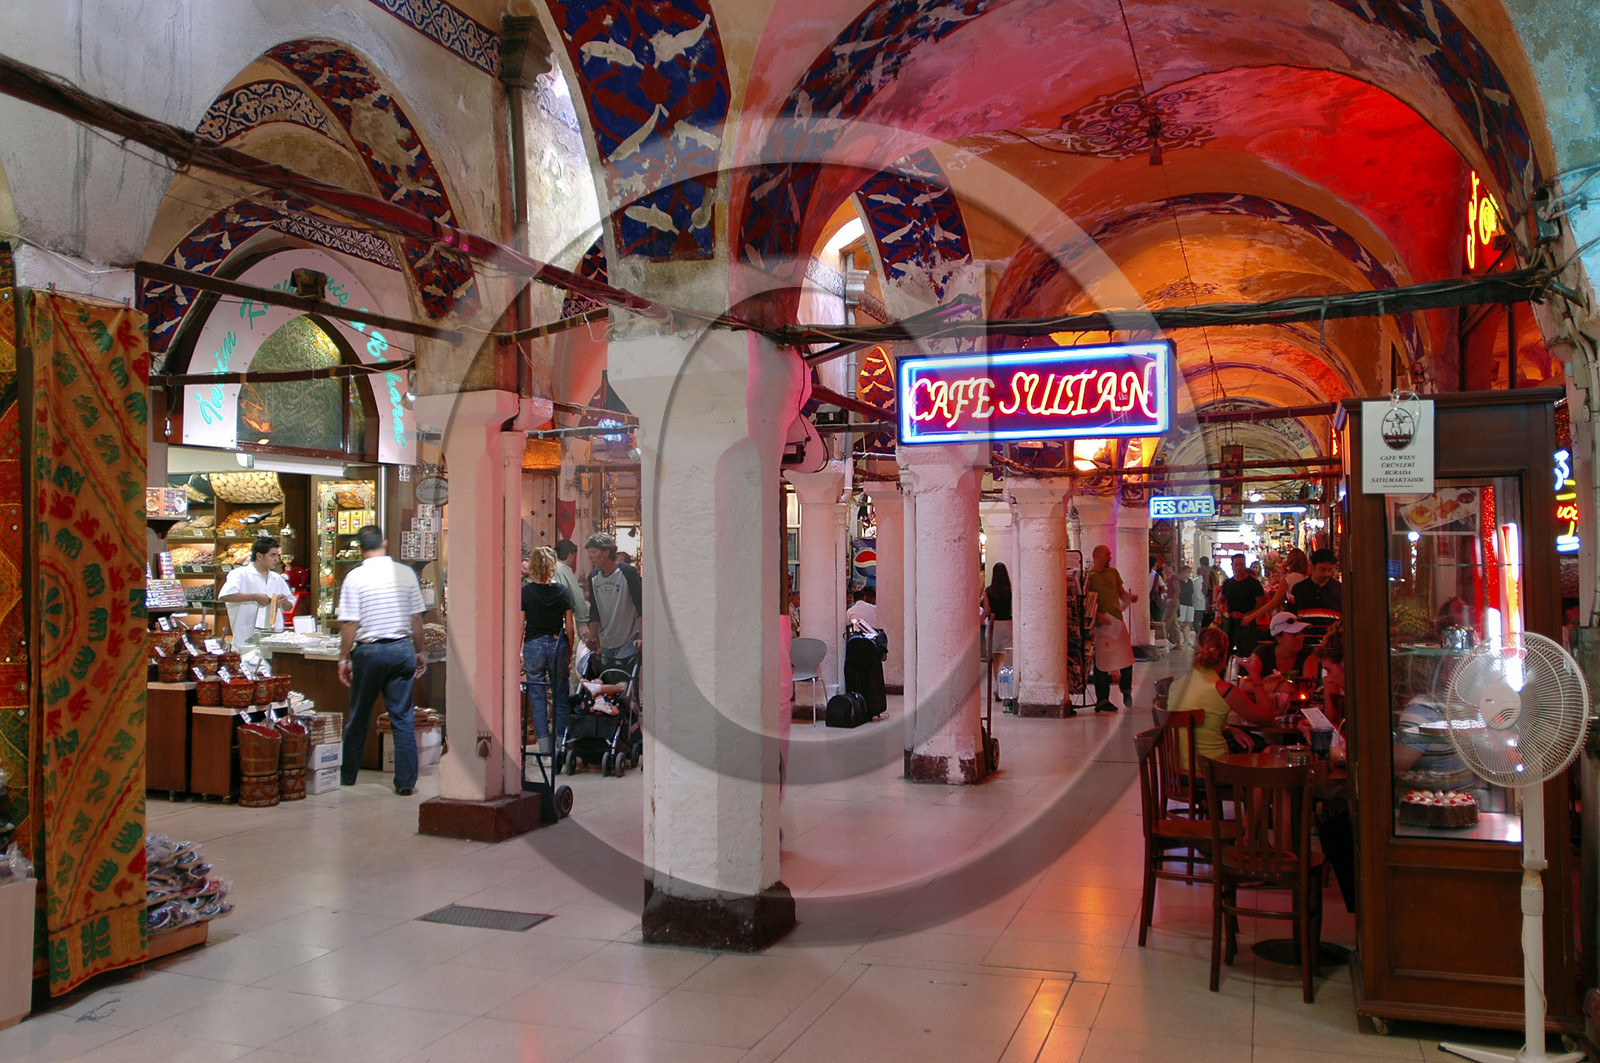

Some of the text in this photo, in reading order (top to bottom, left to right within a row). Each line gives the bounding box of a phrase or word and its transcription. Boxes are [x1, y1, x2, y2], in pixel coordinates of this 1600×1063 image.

[908, 361, 1158, 429] CAFE SULTAN
[1154, 499, 1211, 514] FES CAFE
